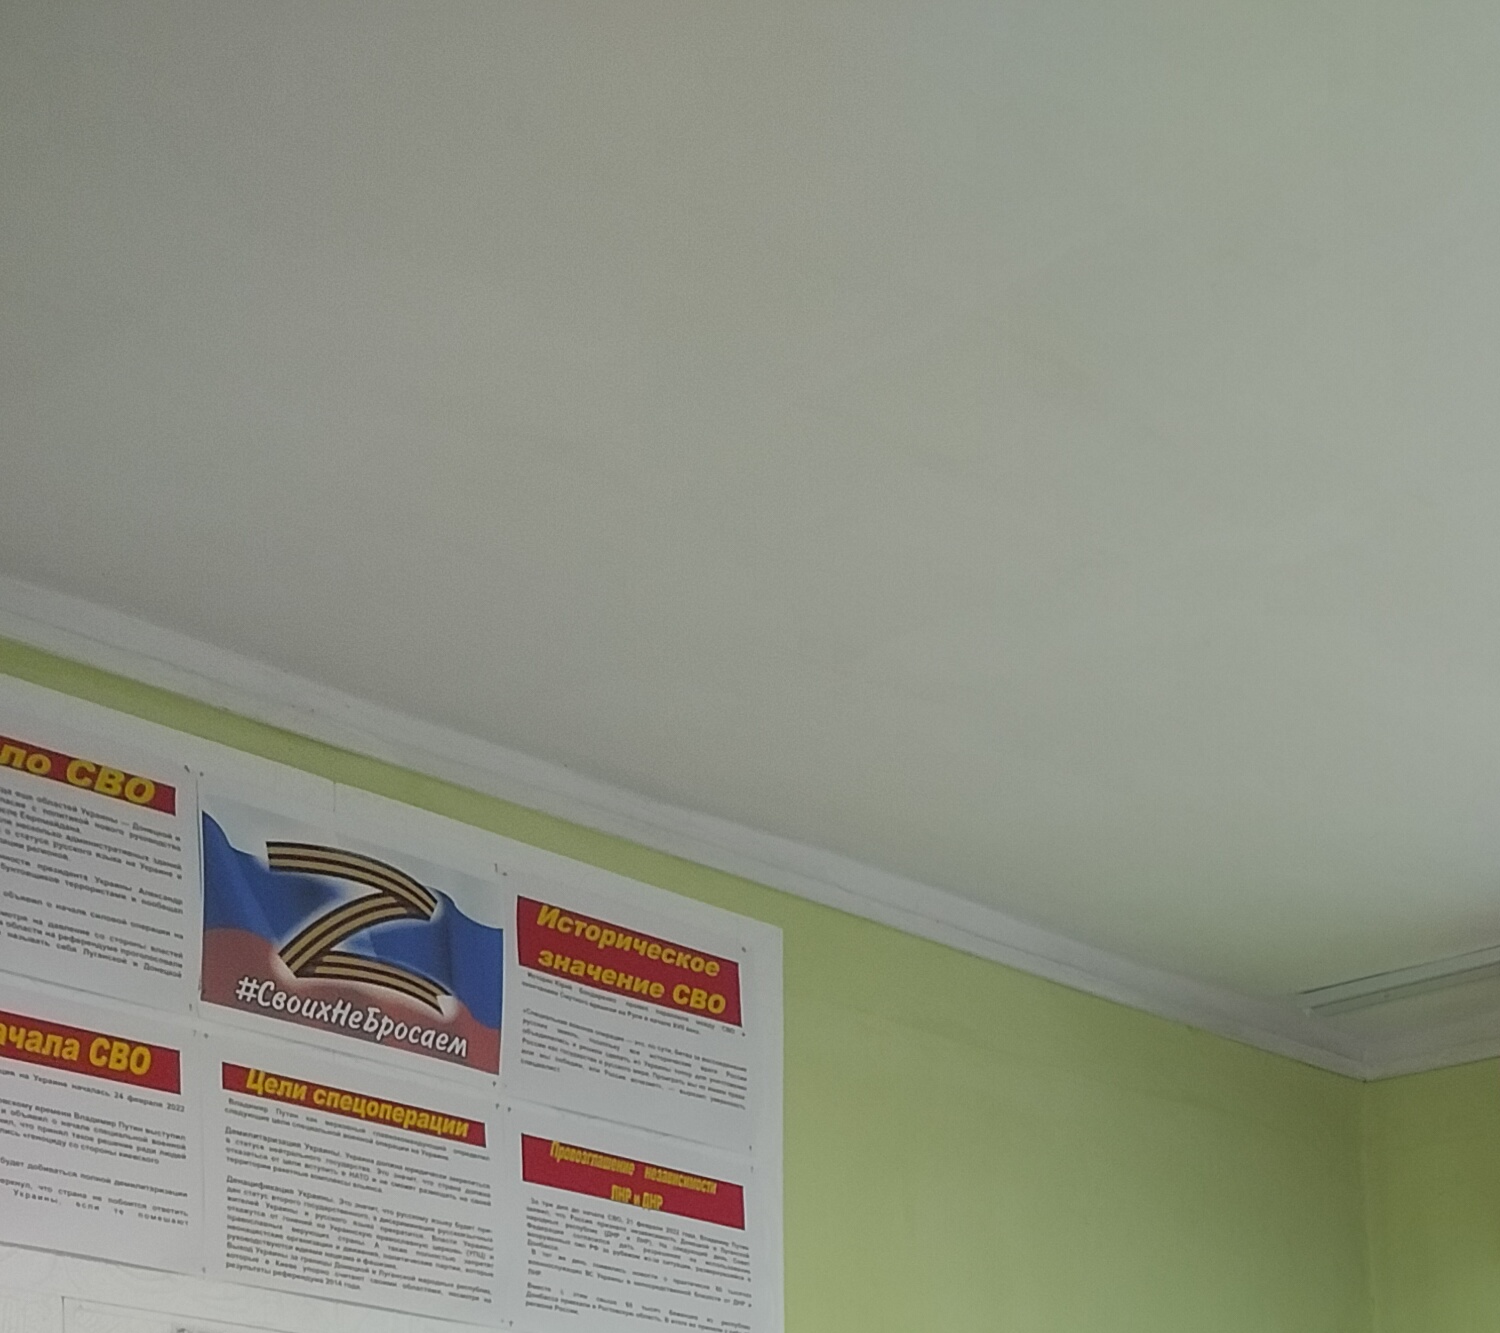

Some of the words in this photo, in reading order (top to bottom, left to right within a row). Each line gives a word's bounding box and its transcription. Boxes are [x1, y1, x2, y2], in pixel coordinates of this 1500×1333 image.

[0, 745, 51, 777] по
[66, 759, 155, 807] СВО
[537, 904, 719, 978] Историческое
[235, 976, 467, 1057] #СвоихНеБросаем
[538, 949, 664, 999] значение
[673, 982, 726, 1017] СВО
[89, 1037, 152, 1076] СВО
[246, 1067, 306, 1101] Цели
[313, 1087, 468, 1137] спецоперации
[610, 1184, 632, 1203] ЛНР
[641, 1192, 664, 1210] ДНР
